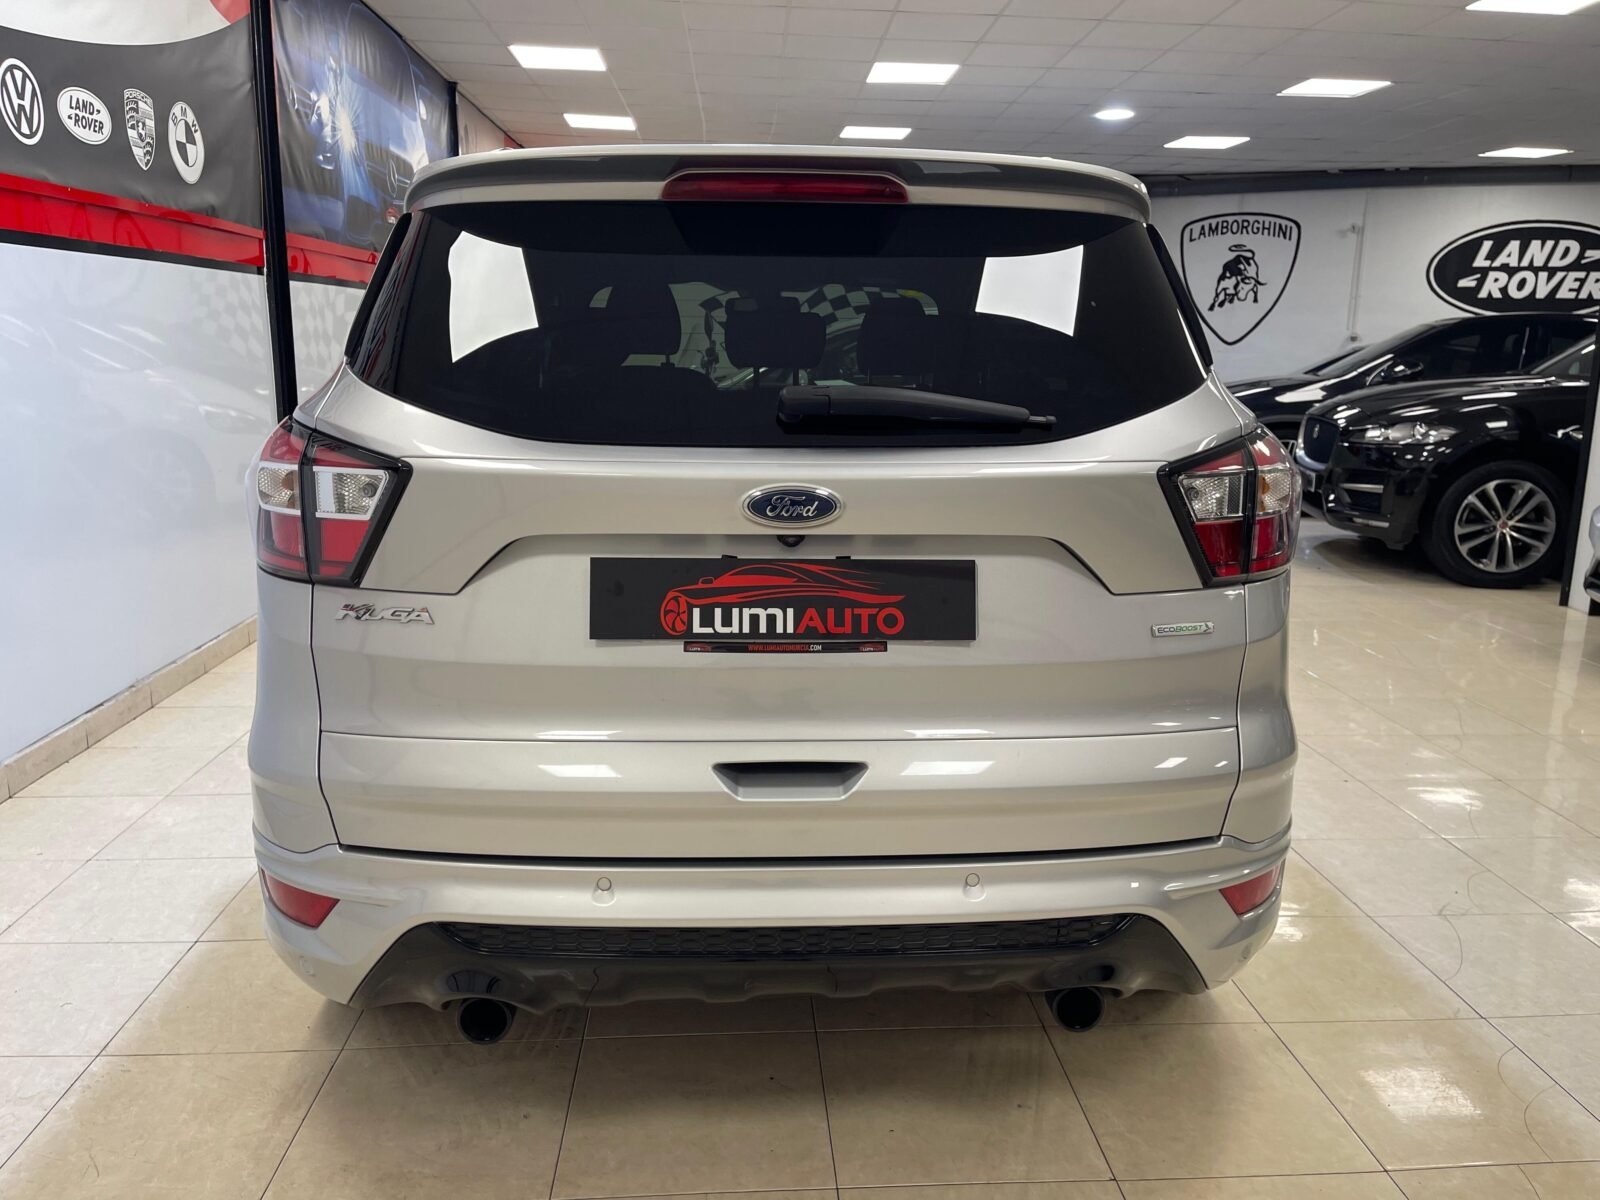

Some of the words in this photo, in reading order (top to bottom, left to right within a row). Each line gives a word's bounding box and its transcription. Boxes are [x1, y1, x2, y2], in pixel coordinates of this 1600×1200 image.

[69, 95, 95, 116] LAND
[73, 116, 104, 135] ROVER
[171, 105, 199, 134] BMW
[1189, 219, 1293, 242] LAMBORGHINI
[1472, 239, 1581, 267] LAND
[1477, 270, 1600, 299] ROVER
[766, 494, 818, 517] Ford
[336, 603, 435, 625] KUGA
[1157, 624, 1203, 634] ECOBOOST
